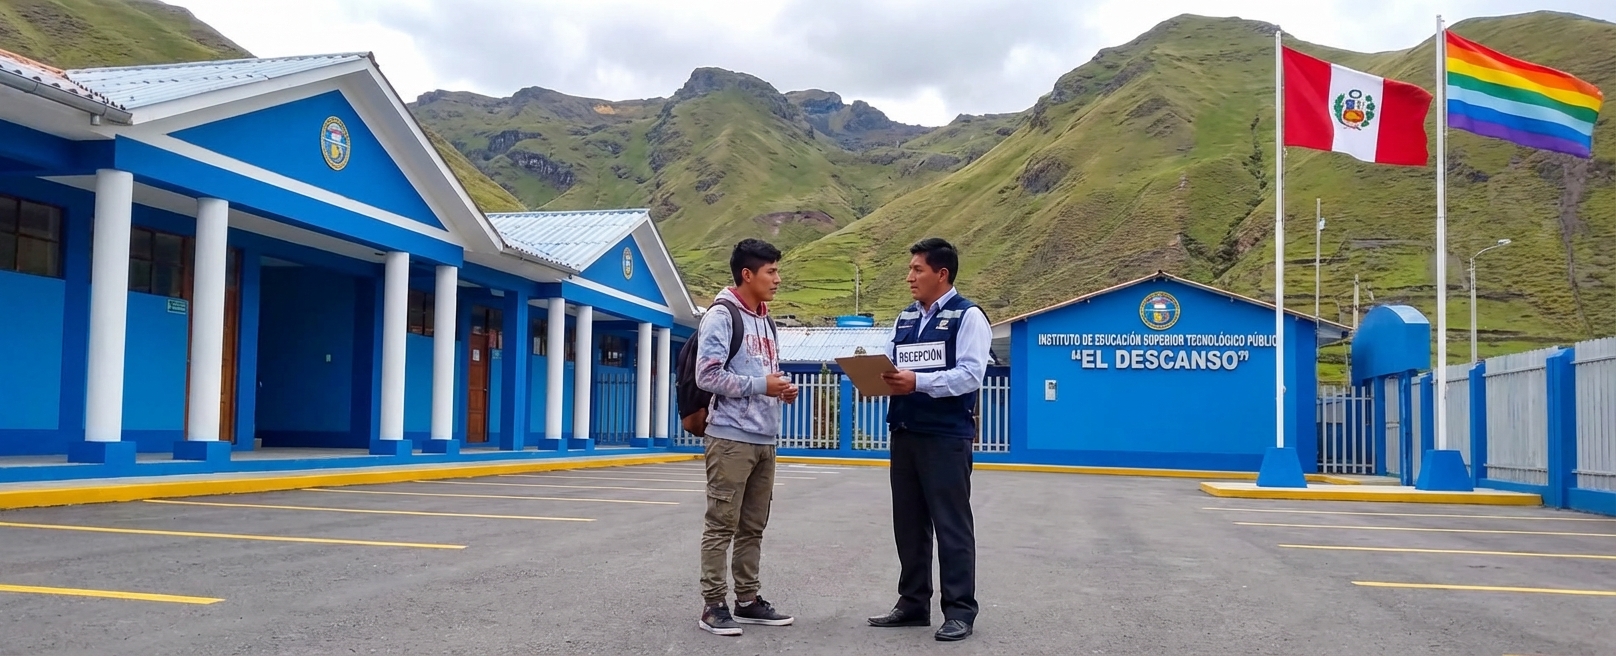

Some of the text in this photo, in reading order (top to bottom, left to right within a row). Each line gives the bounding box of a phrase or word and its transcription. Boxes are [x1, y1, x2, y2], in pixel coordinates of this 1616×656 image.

[1038, 333, 1081, 346] INSTITUTO
[1082, 333, 1093, 346] DE
[1247, 331, 1277, 347] PÚBLIC
